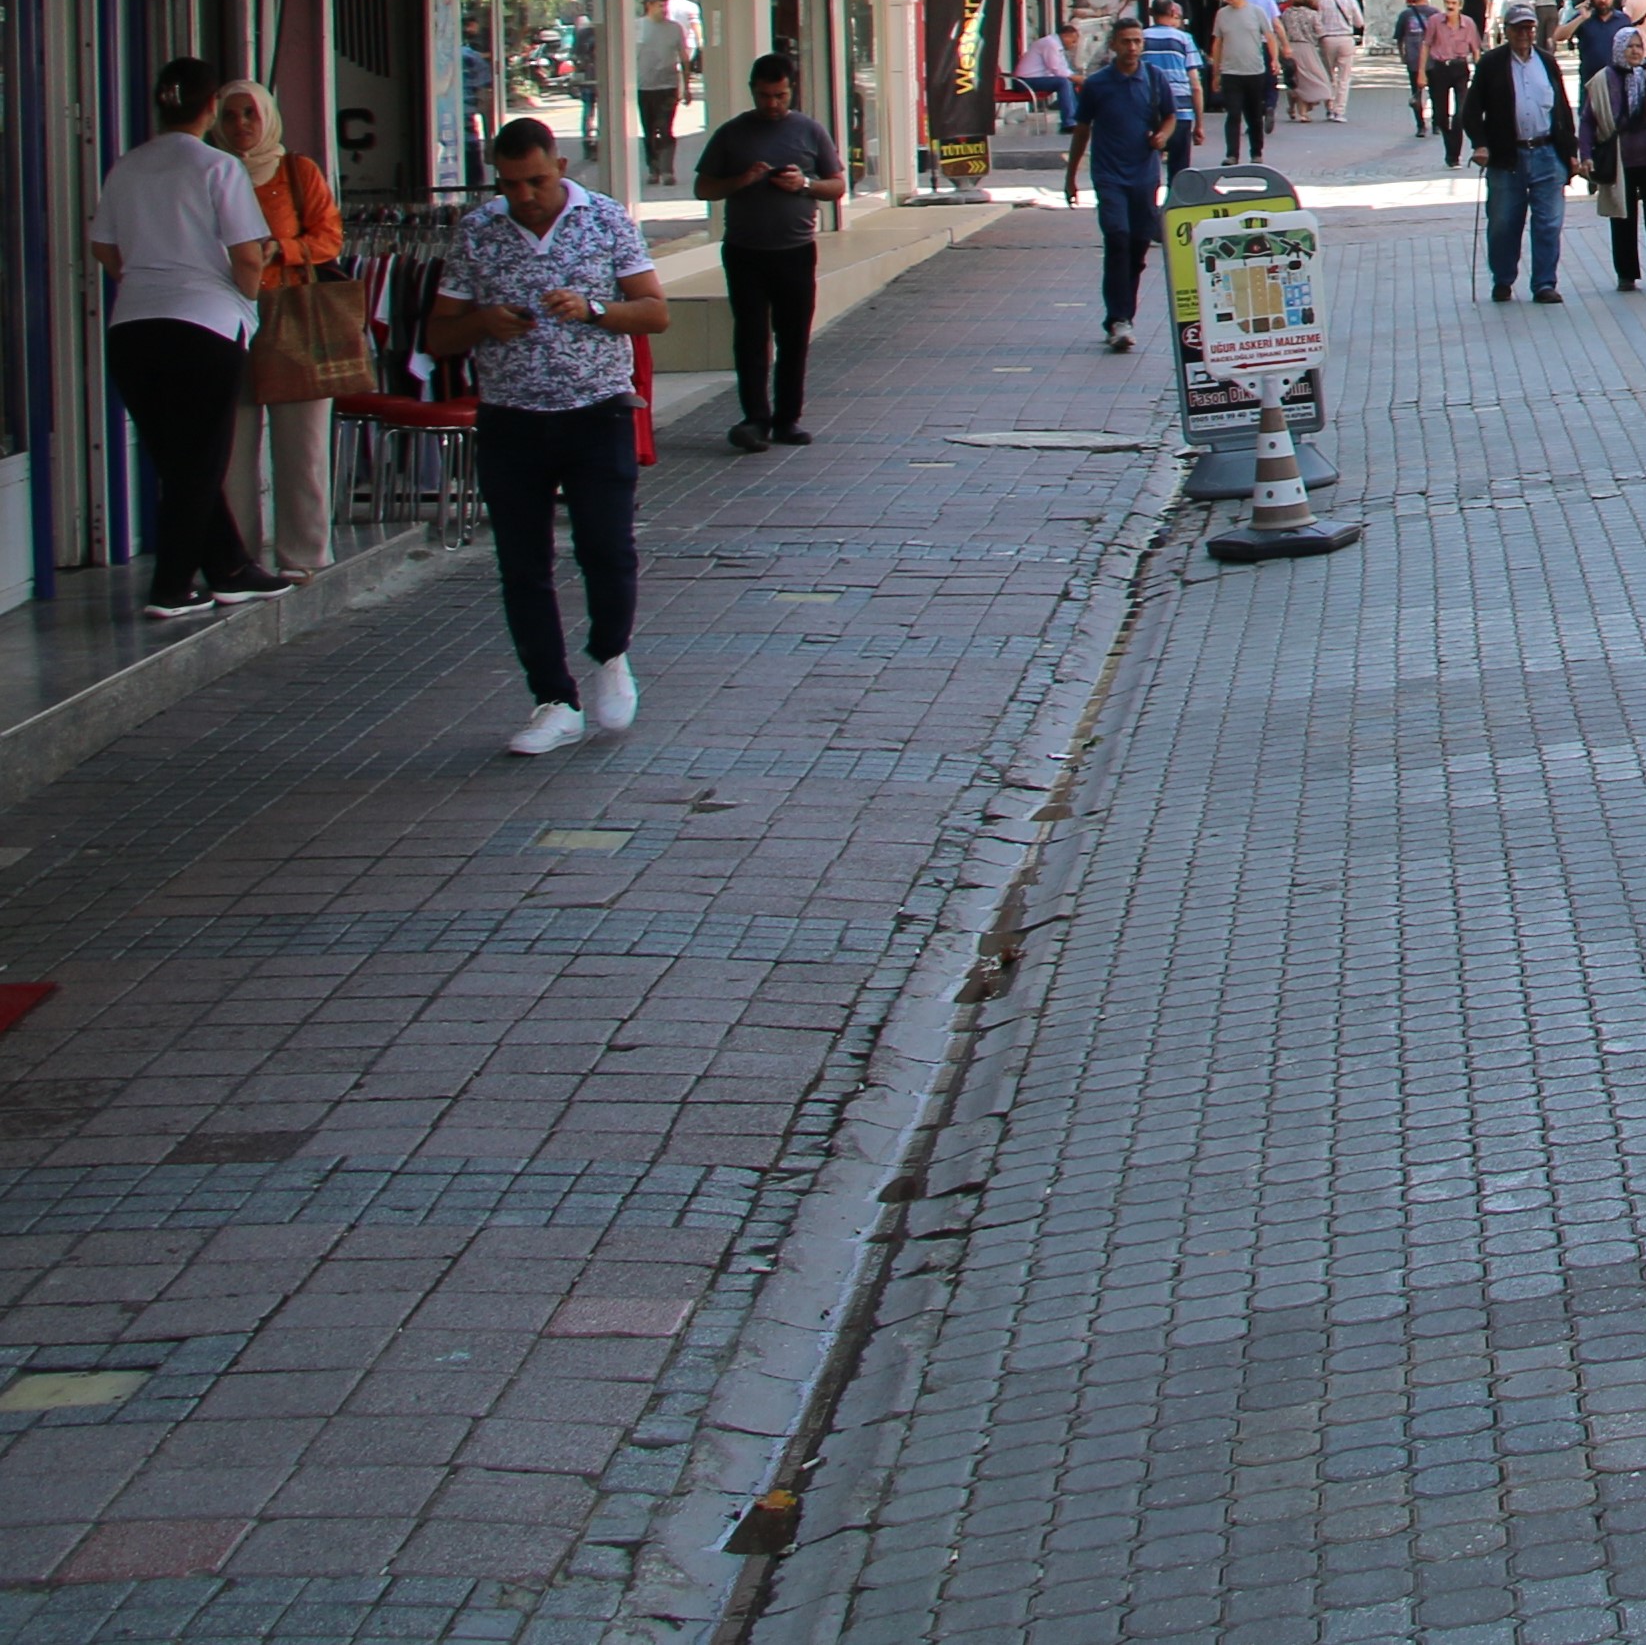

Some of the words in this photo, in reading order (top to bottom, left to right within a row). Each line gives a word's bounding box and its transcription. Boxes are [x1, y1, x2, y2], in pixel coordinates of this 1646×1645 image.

[941, 140, 985, 157] TÜTÜNCÜ
[1210, 341, 1237, 355] UĞUR
[1239, 336, 1273, 351] ASKERİ
[1275, 333, 1321, 347] MALZEME
[1188, 387, 1227, 408] Fason
[1282, 382, 1312, 401] pılır.
